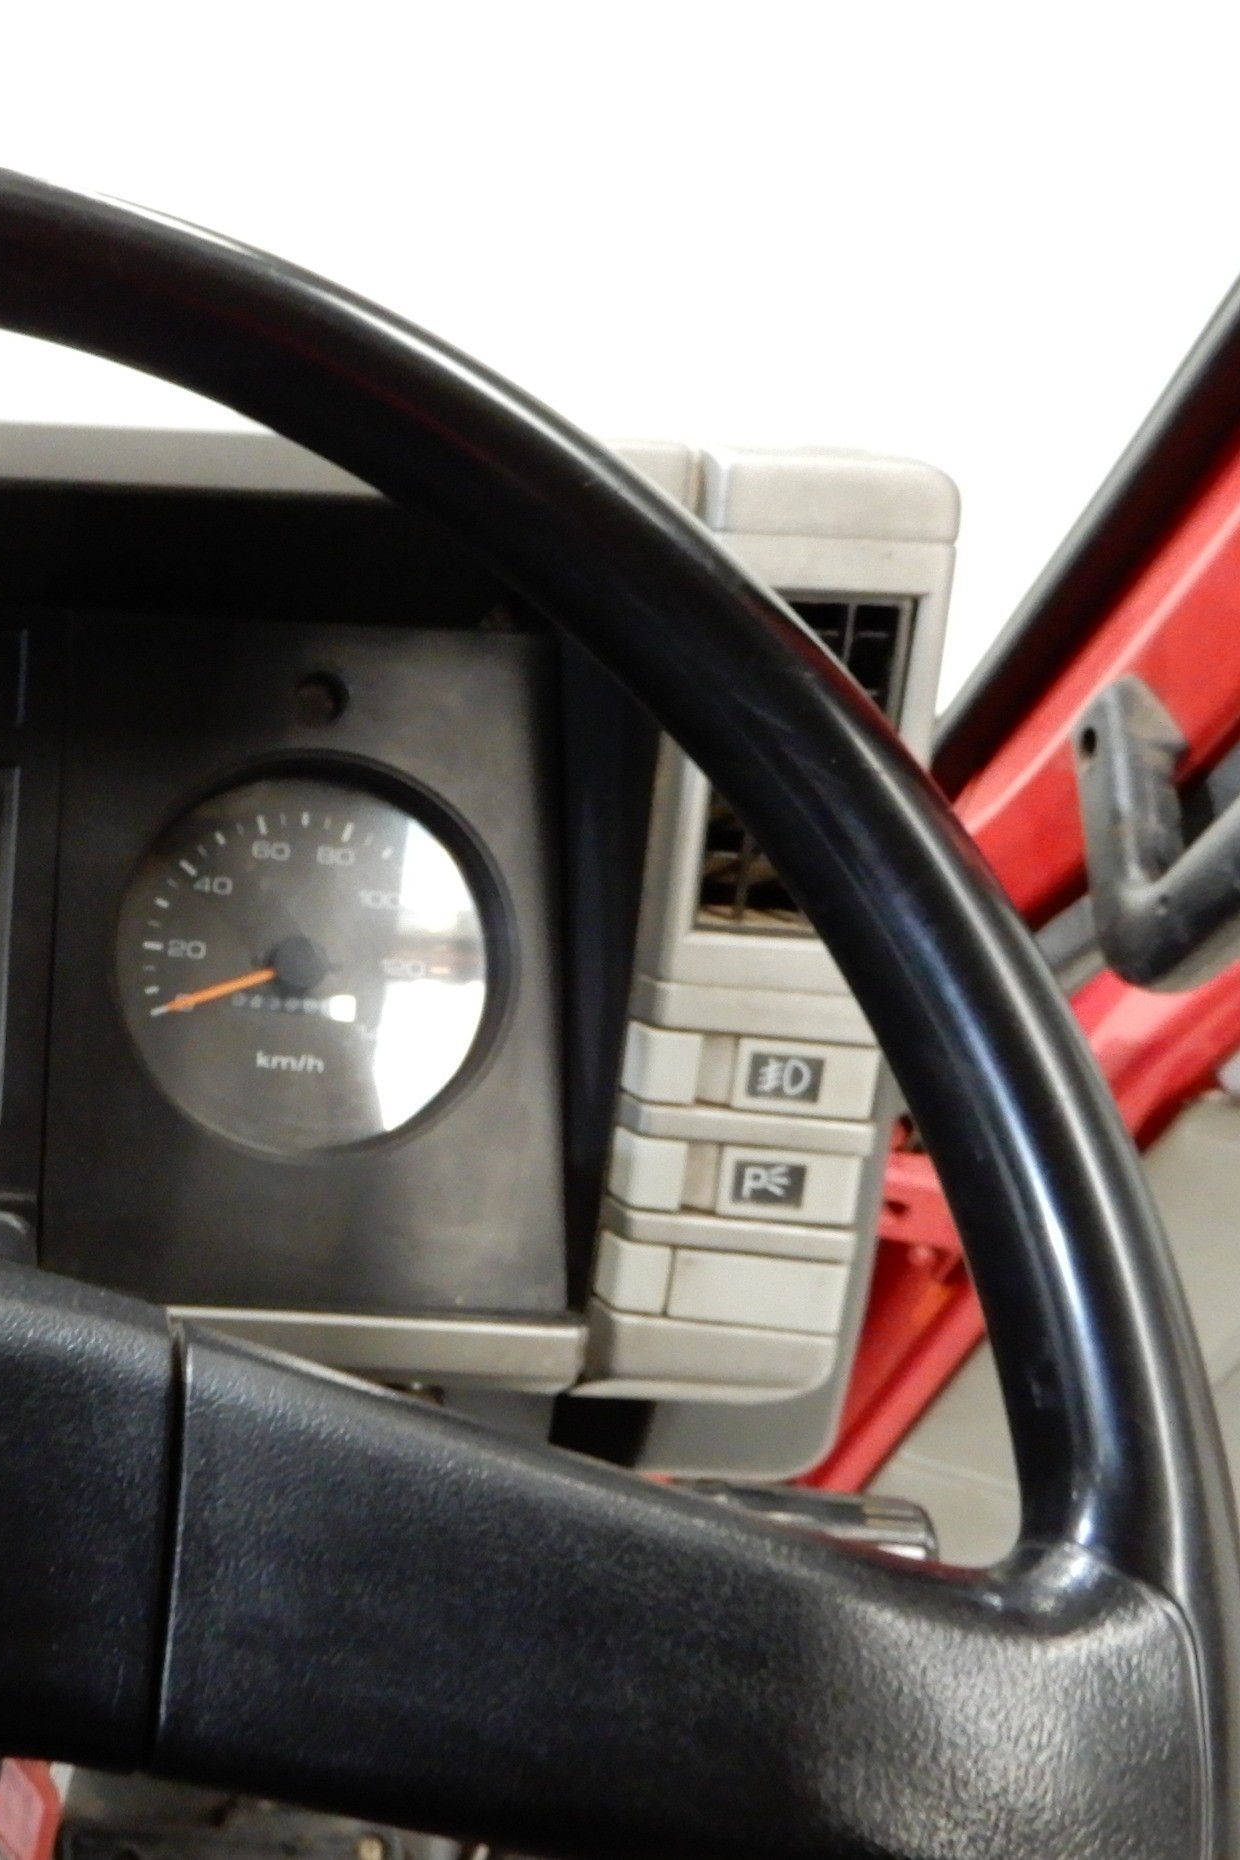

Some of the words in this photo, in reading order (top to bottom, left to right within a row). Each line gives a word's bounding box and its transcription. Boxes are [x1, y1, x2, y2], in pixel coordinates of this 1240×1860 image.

[252, 841, 291, 862] 60
[316, 846, 356, 867] 80
[193, 877, 233, 896] 40
[167, 939, 207, 960] 20
[255, 1050, 325, 1074] km/h
